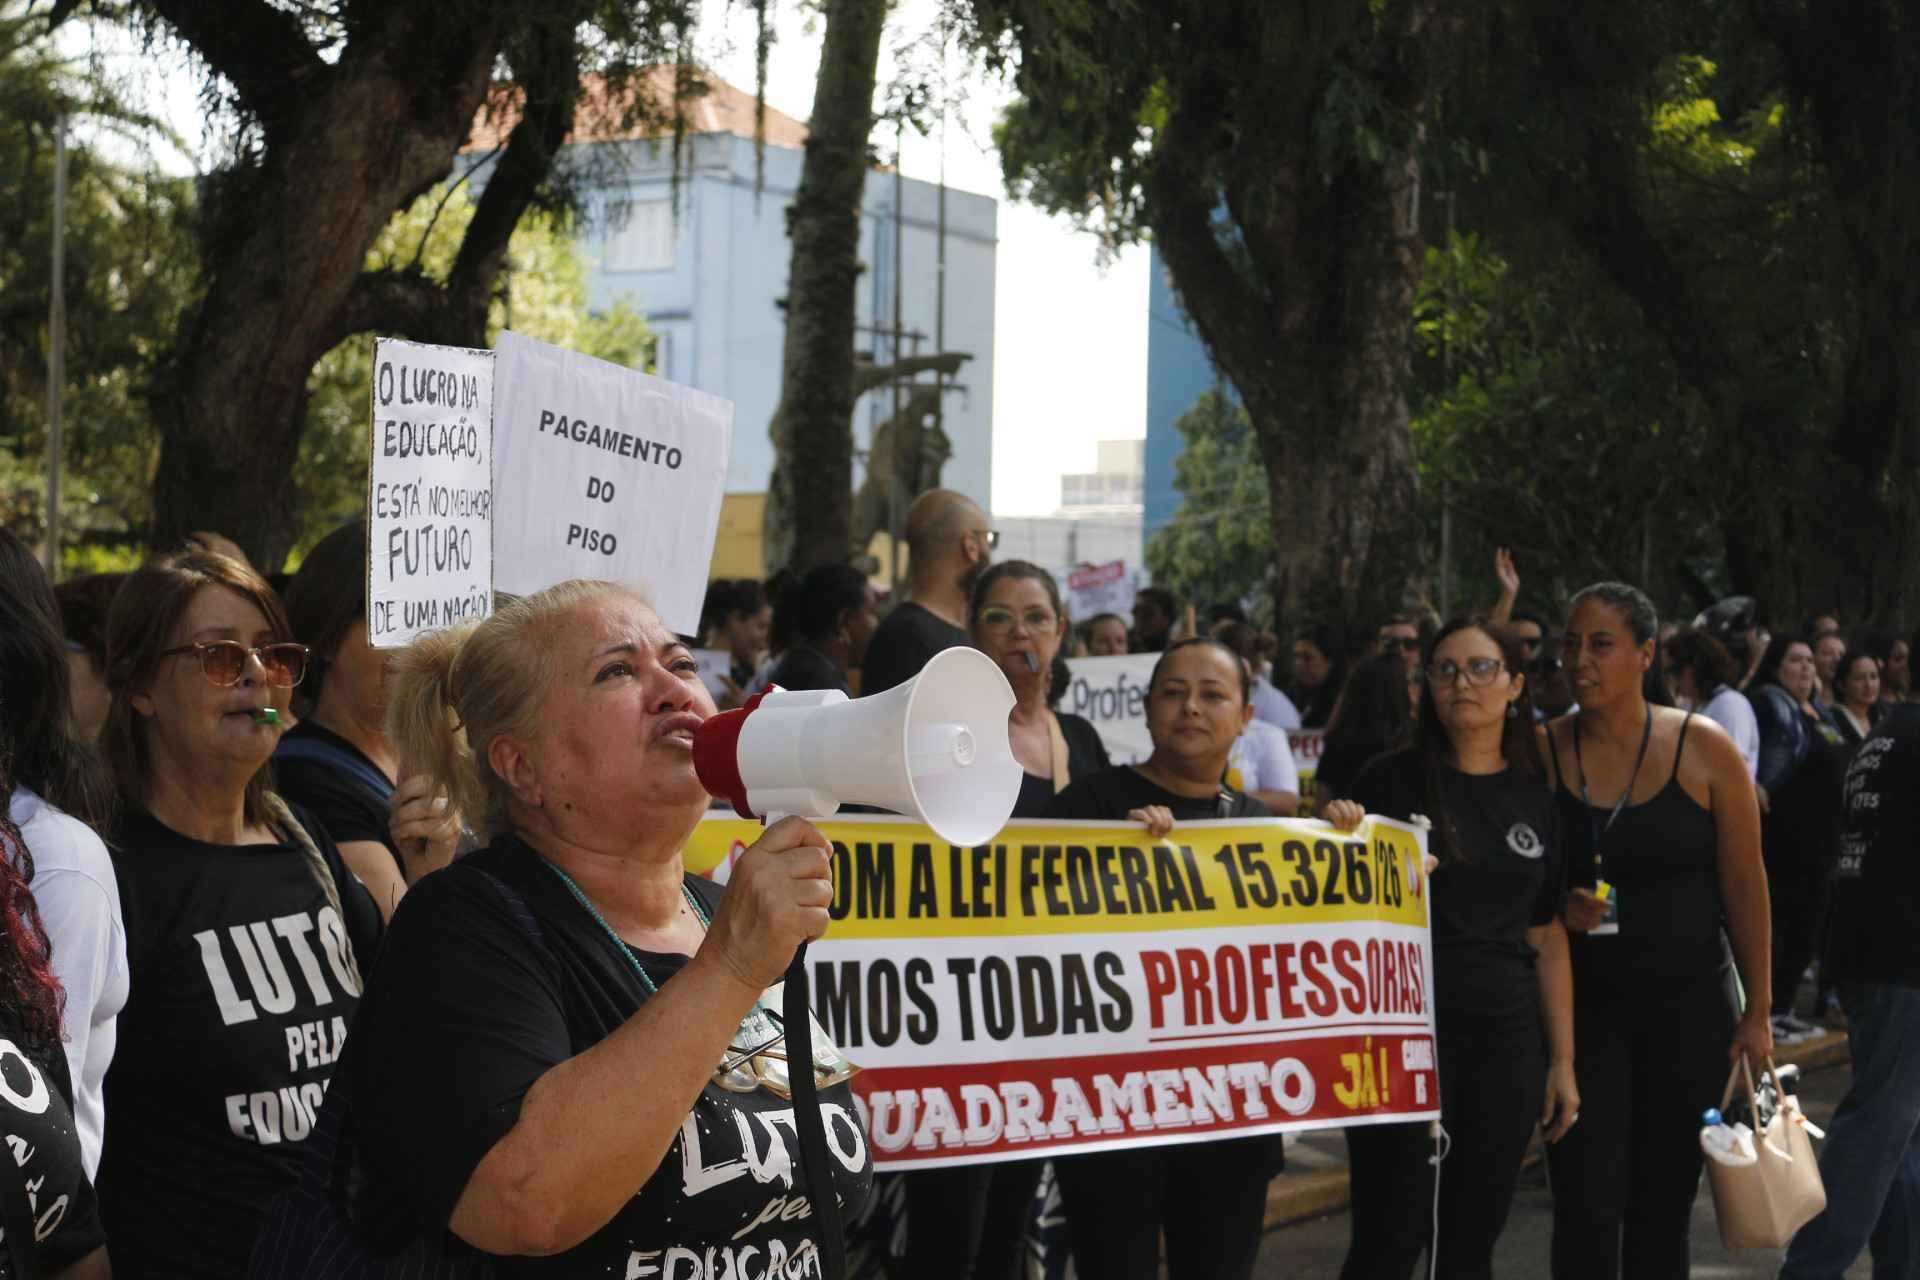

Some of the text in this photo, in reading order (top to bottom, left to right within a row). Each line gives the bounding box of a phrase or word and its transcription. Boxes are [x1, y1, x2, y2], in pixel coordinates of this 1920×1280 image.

[379, 361, 479, 409] O LUCRO NA
[384, 416, 482, 464] EDUCAÇÃO,
[539, 410, 682, 469] PAGAMENTO
[377, 476, 490, 520] ESTÁ NO MELHOR
[586, 476, 615, 503] DO
[388, 524, 472, 582] FUTURO
[566, 524, 617, 556] PISO
[375, 601, 396, 635] DE
[404, 599, 438, 628] UMA
[1073, 673, 1149, 720] Profe
[829, 838, 1402, 920] OM A LEI FEDERAL 15.326/26
[193, 906, 362, 1026] LUTO
[802, 938, 1428, 1050] MOS TODAS PROFESSORAS!
[225, 1078, 330, 1145] EDUC
[851, 1034, 1390, 1153] UADRAMENTO JÁ!
[680, 1102, 867, 1197] LUTO
